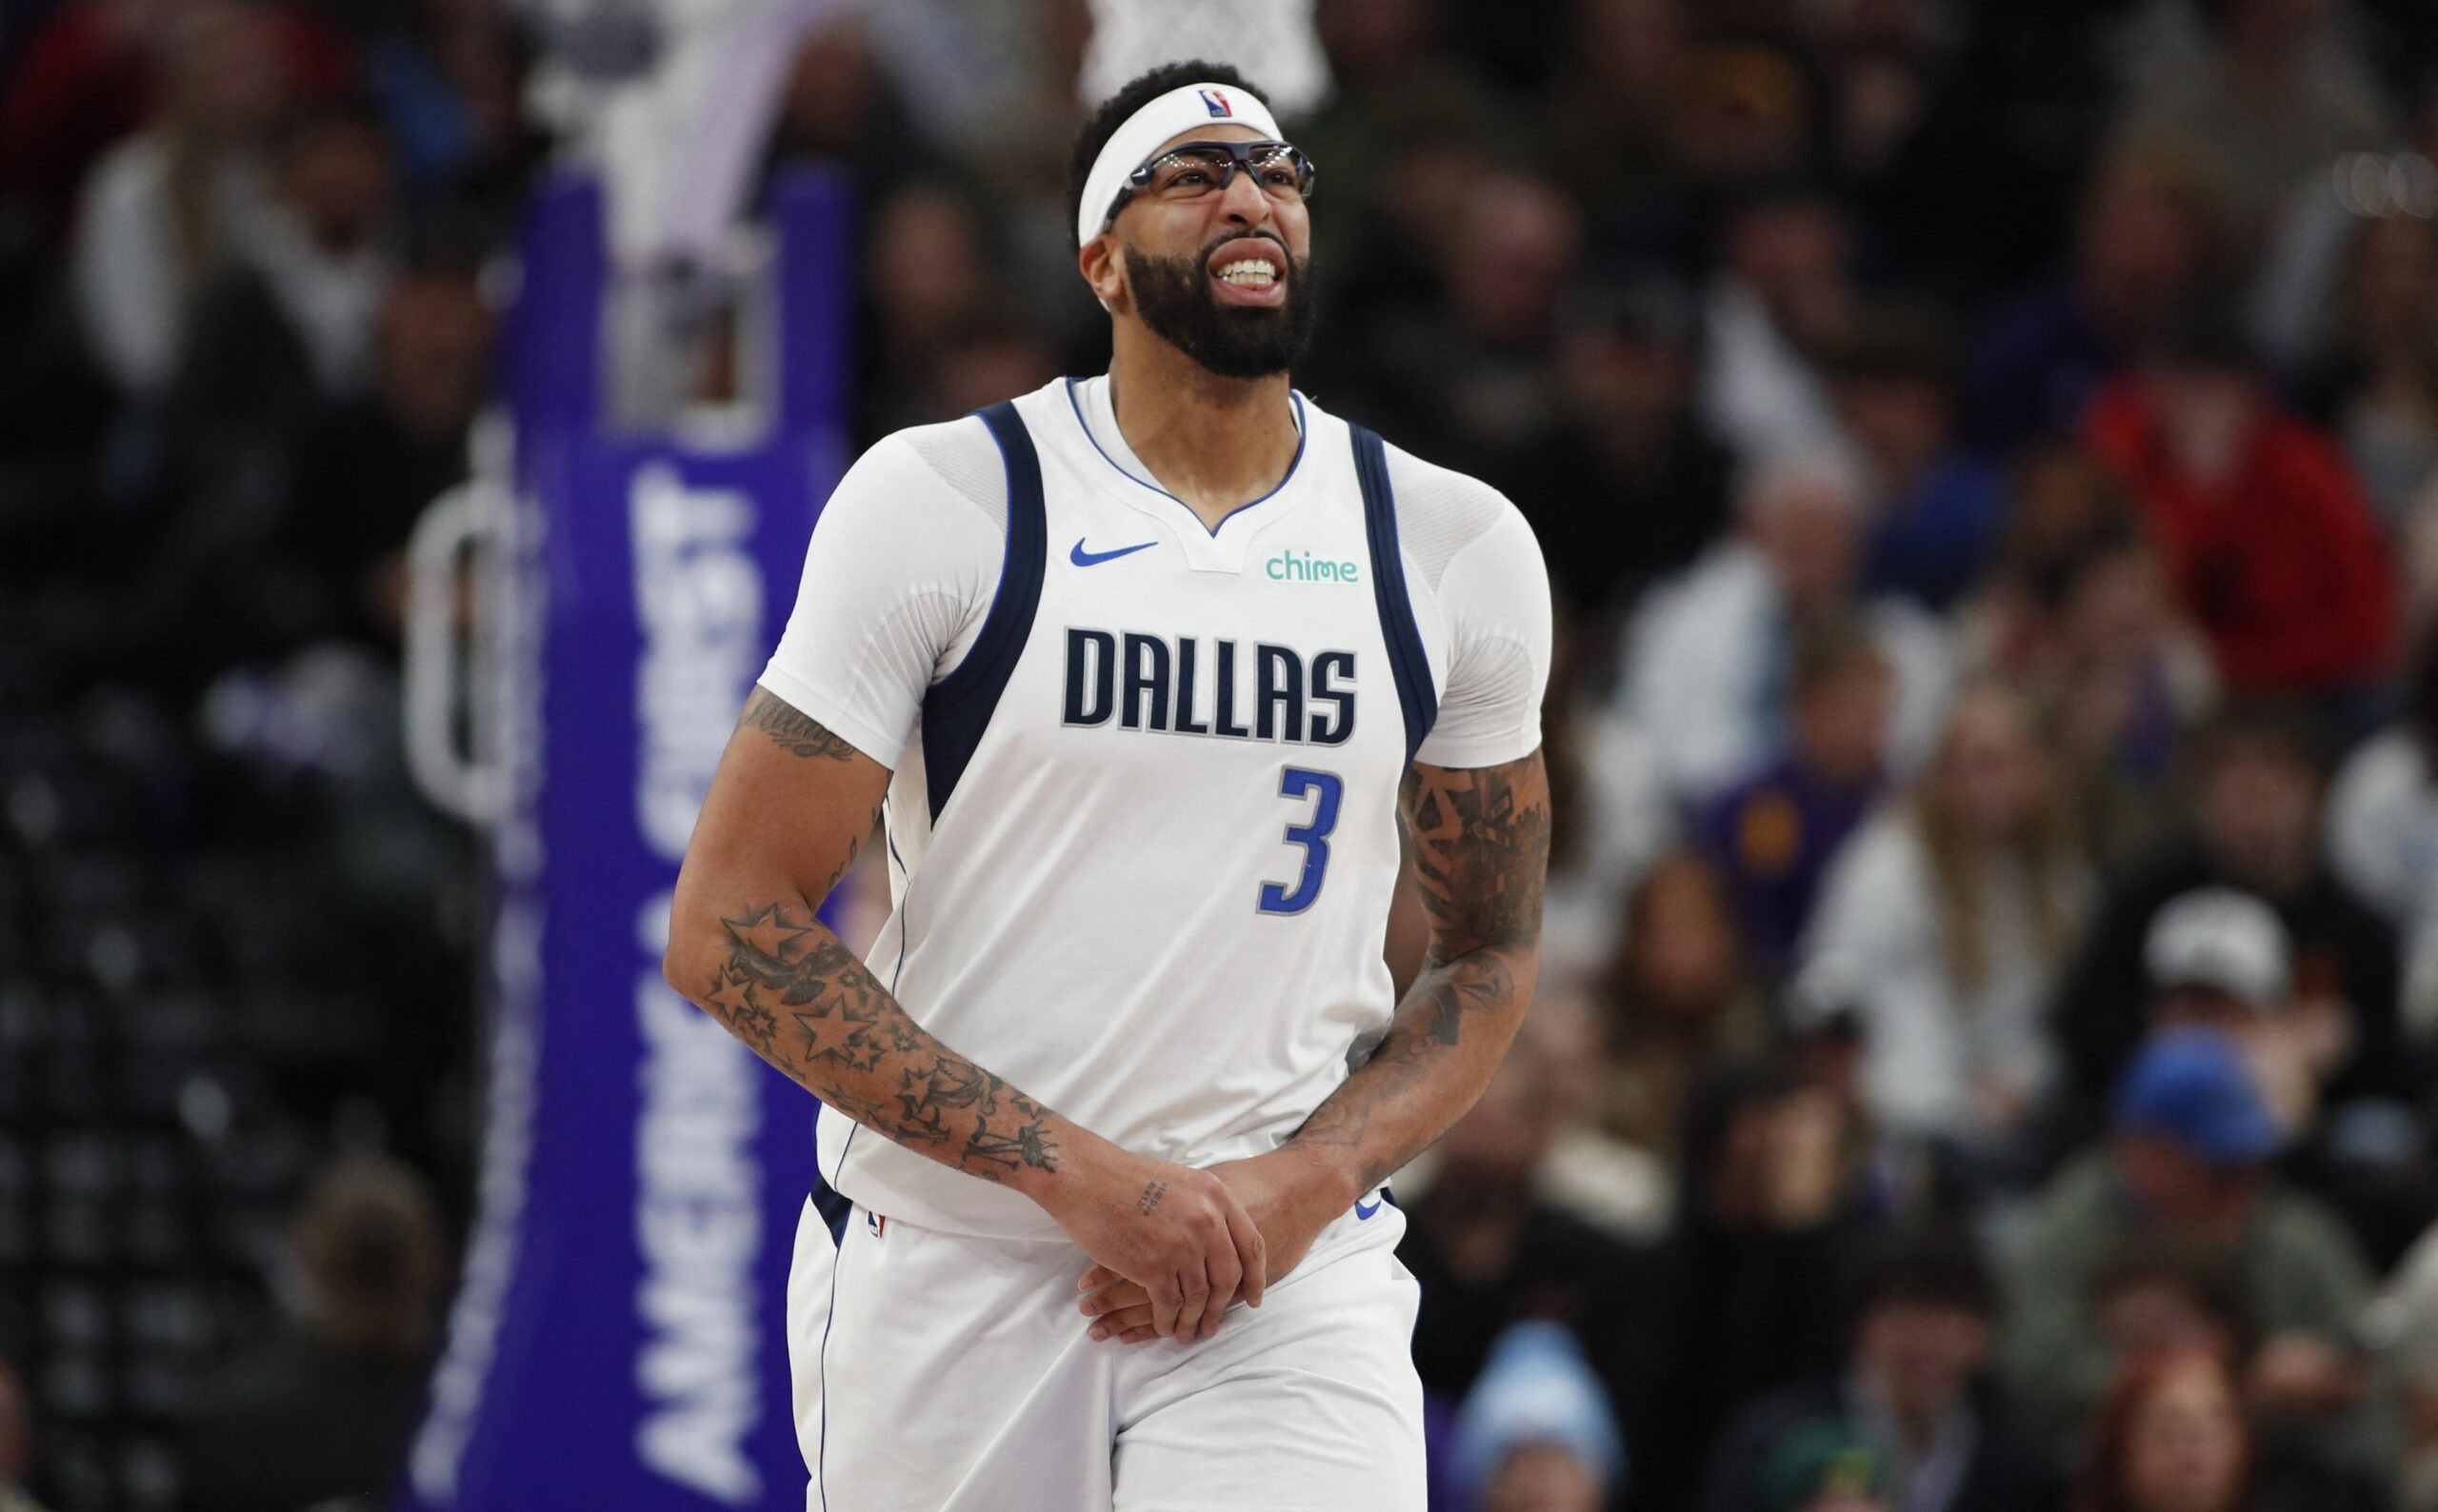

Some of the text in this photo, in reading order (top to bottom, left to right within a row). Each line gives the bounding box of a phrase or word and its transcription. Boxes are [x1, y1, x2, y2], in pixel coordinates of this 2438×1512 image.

[1266, 549, 1358, 583] chime
[1060, 625, 1358, 748] DALLAS
[1256, 764, 1344, 917] 3
